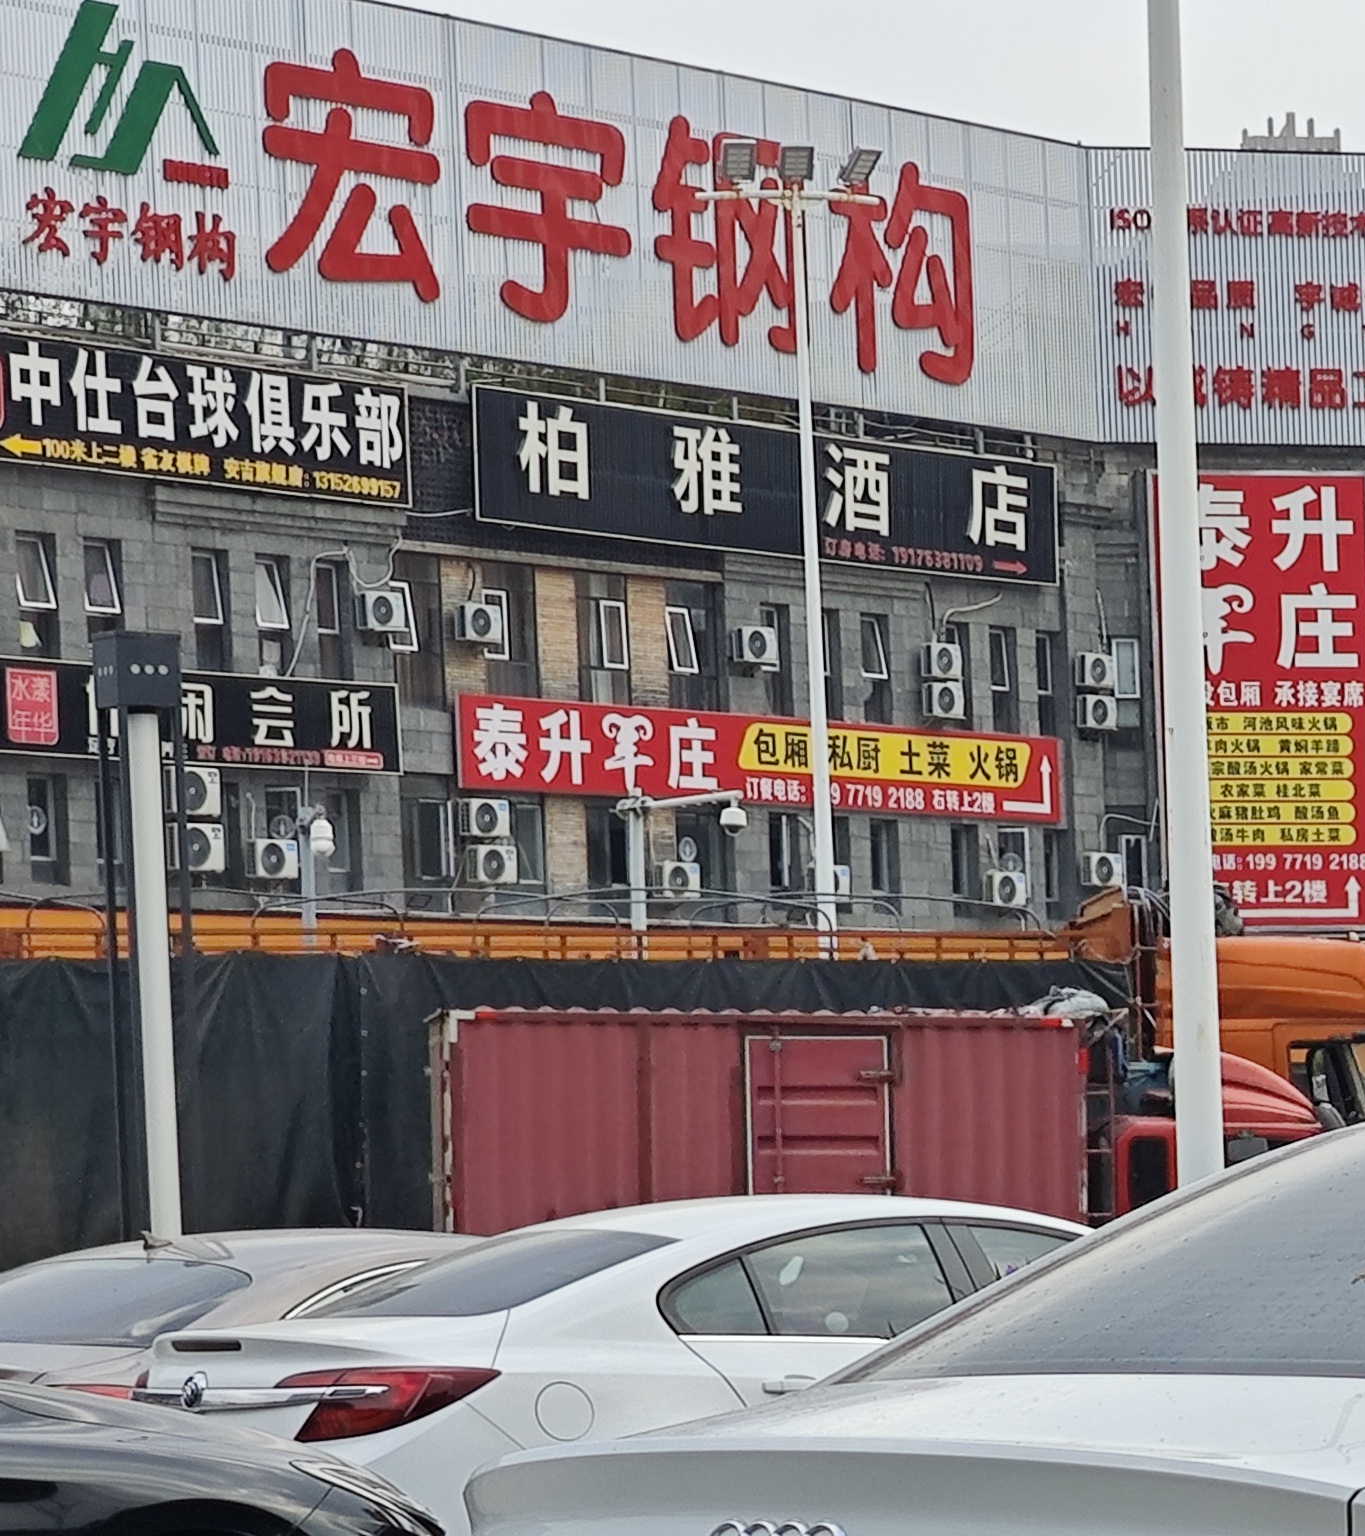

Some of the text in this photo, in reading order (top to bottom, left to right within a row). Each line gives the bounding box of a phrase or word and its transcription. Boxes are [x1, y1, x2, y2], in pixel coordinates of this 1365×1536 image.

[262, 48, 975, 387] 宏宇钢构
[23, 186, 237, 282] 宏宇钢构
[9, 341, 403, 469] 中仕台球俱乐部
[518, 401, 1029, 552] 柏雅酒店
[1274, 680, 1365, 708] 承接宴席
[1243, 716, 1338, 732] 河池风味火锅
[753, 728, 1019, 783] 包厢 私厨 土菜 火锅
[1298, 761, 1345, 776] 家常菜
[846, 784, 883, 808] 7719
[888, 786, 925, 810] 2188
[1220, 783, 1322, 799] 农家菜 桂北菜
[1294, 805, 1341, 821] 酸汤鱼
[1279, 828, 1342, 843] 私房土菜
[1246, 853, 1277, 871] 199
[1283, 853, 1323, 871] 7719
